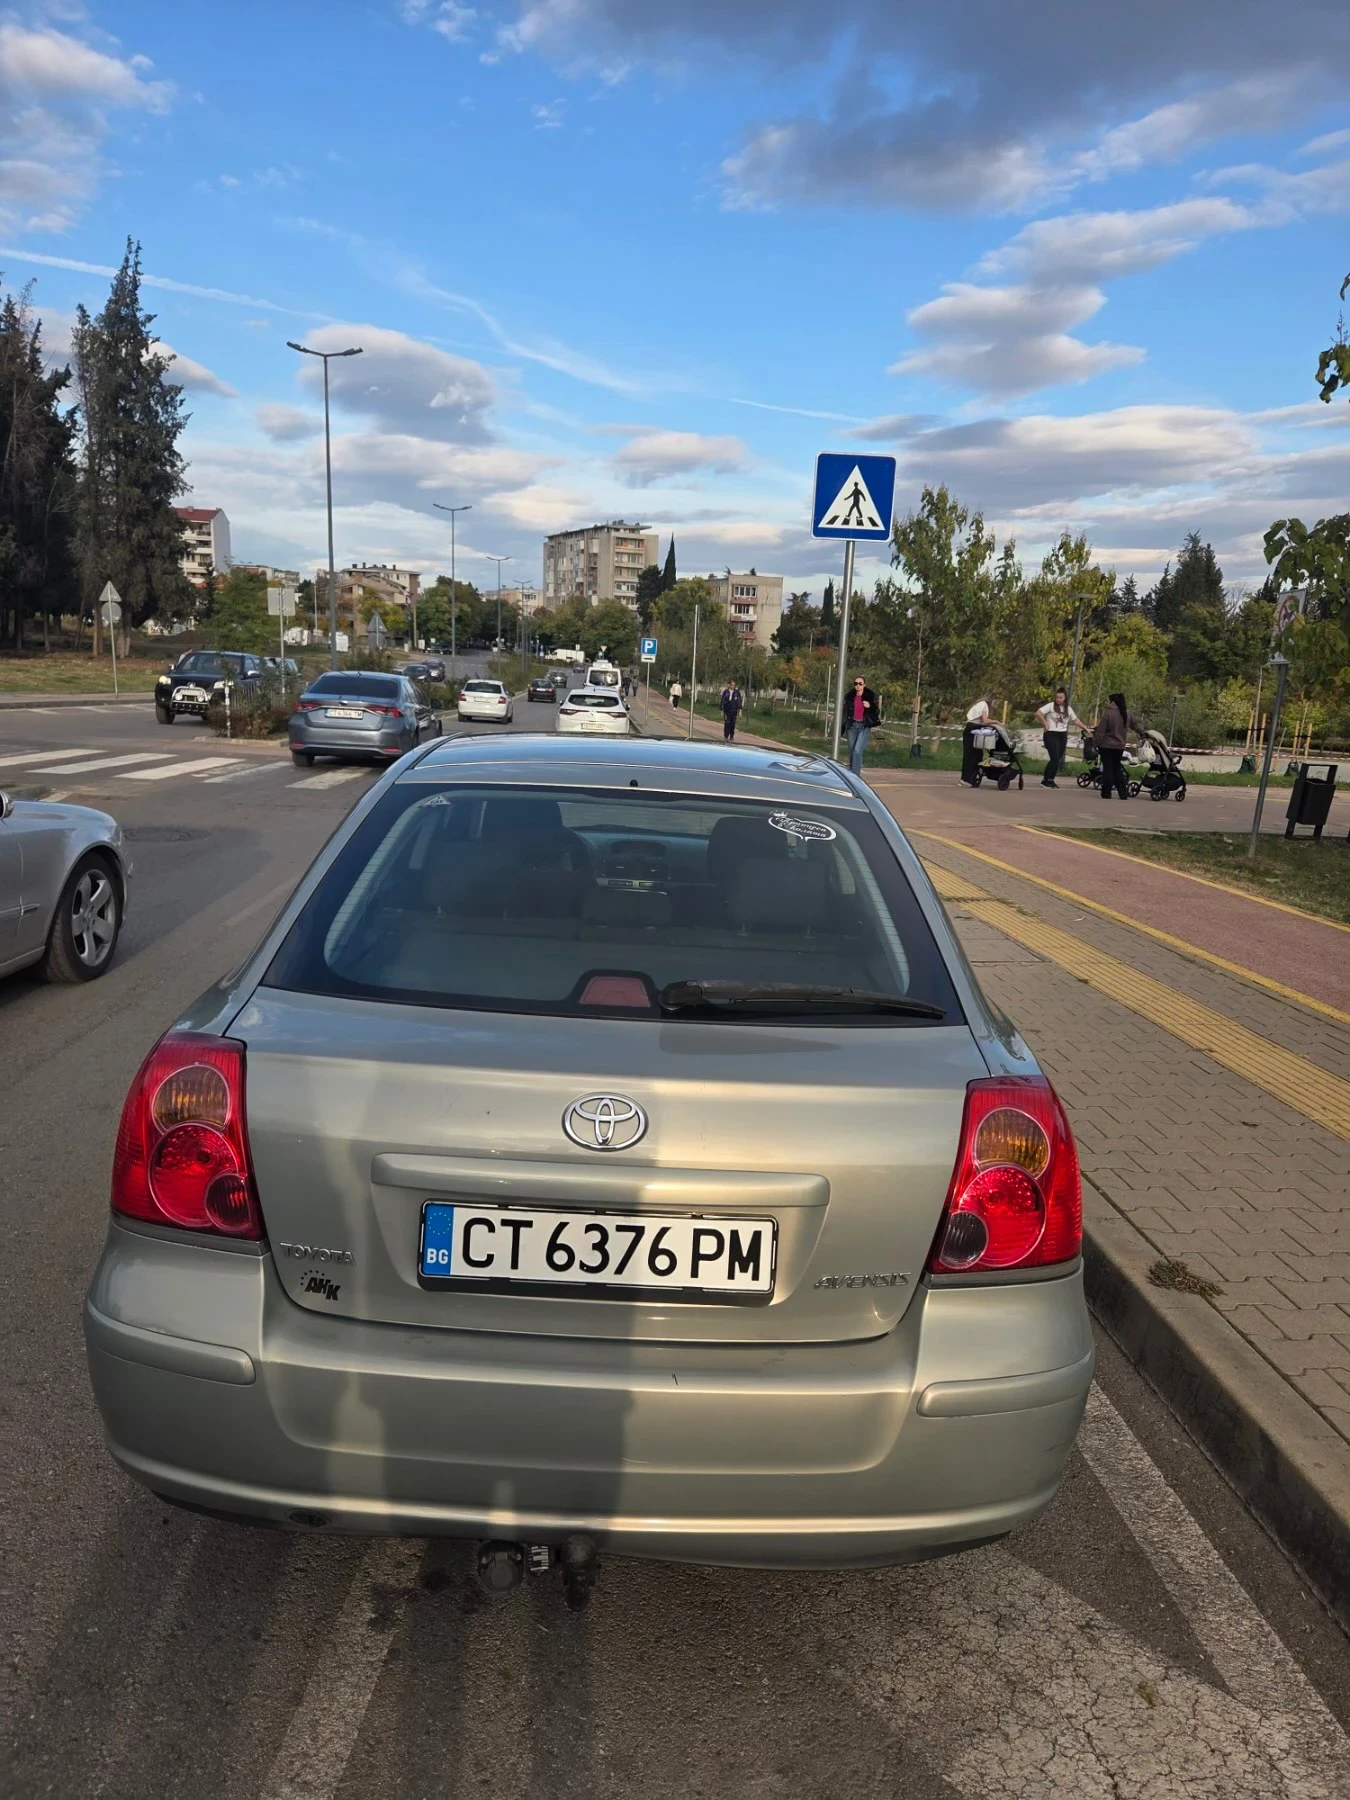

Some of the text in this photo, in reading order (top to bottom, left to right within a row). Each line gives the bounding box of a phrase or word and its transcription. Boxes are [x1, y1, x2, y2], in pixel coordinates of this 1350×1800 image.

[644, 640, 654, 653] P
[280, 1242, 355, 1265] TOYOTA
[426, 1247, 449, 1265] BG
[461, 1217, 762, 1281] CT 6376 PM
[814, 1272, 911, 1290] AVENSIS
